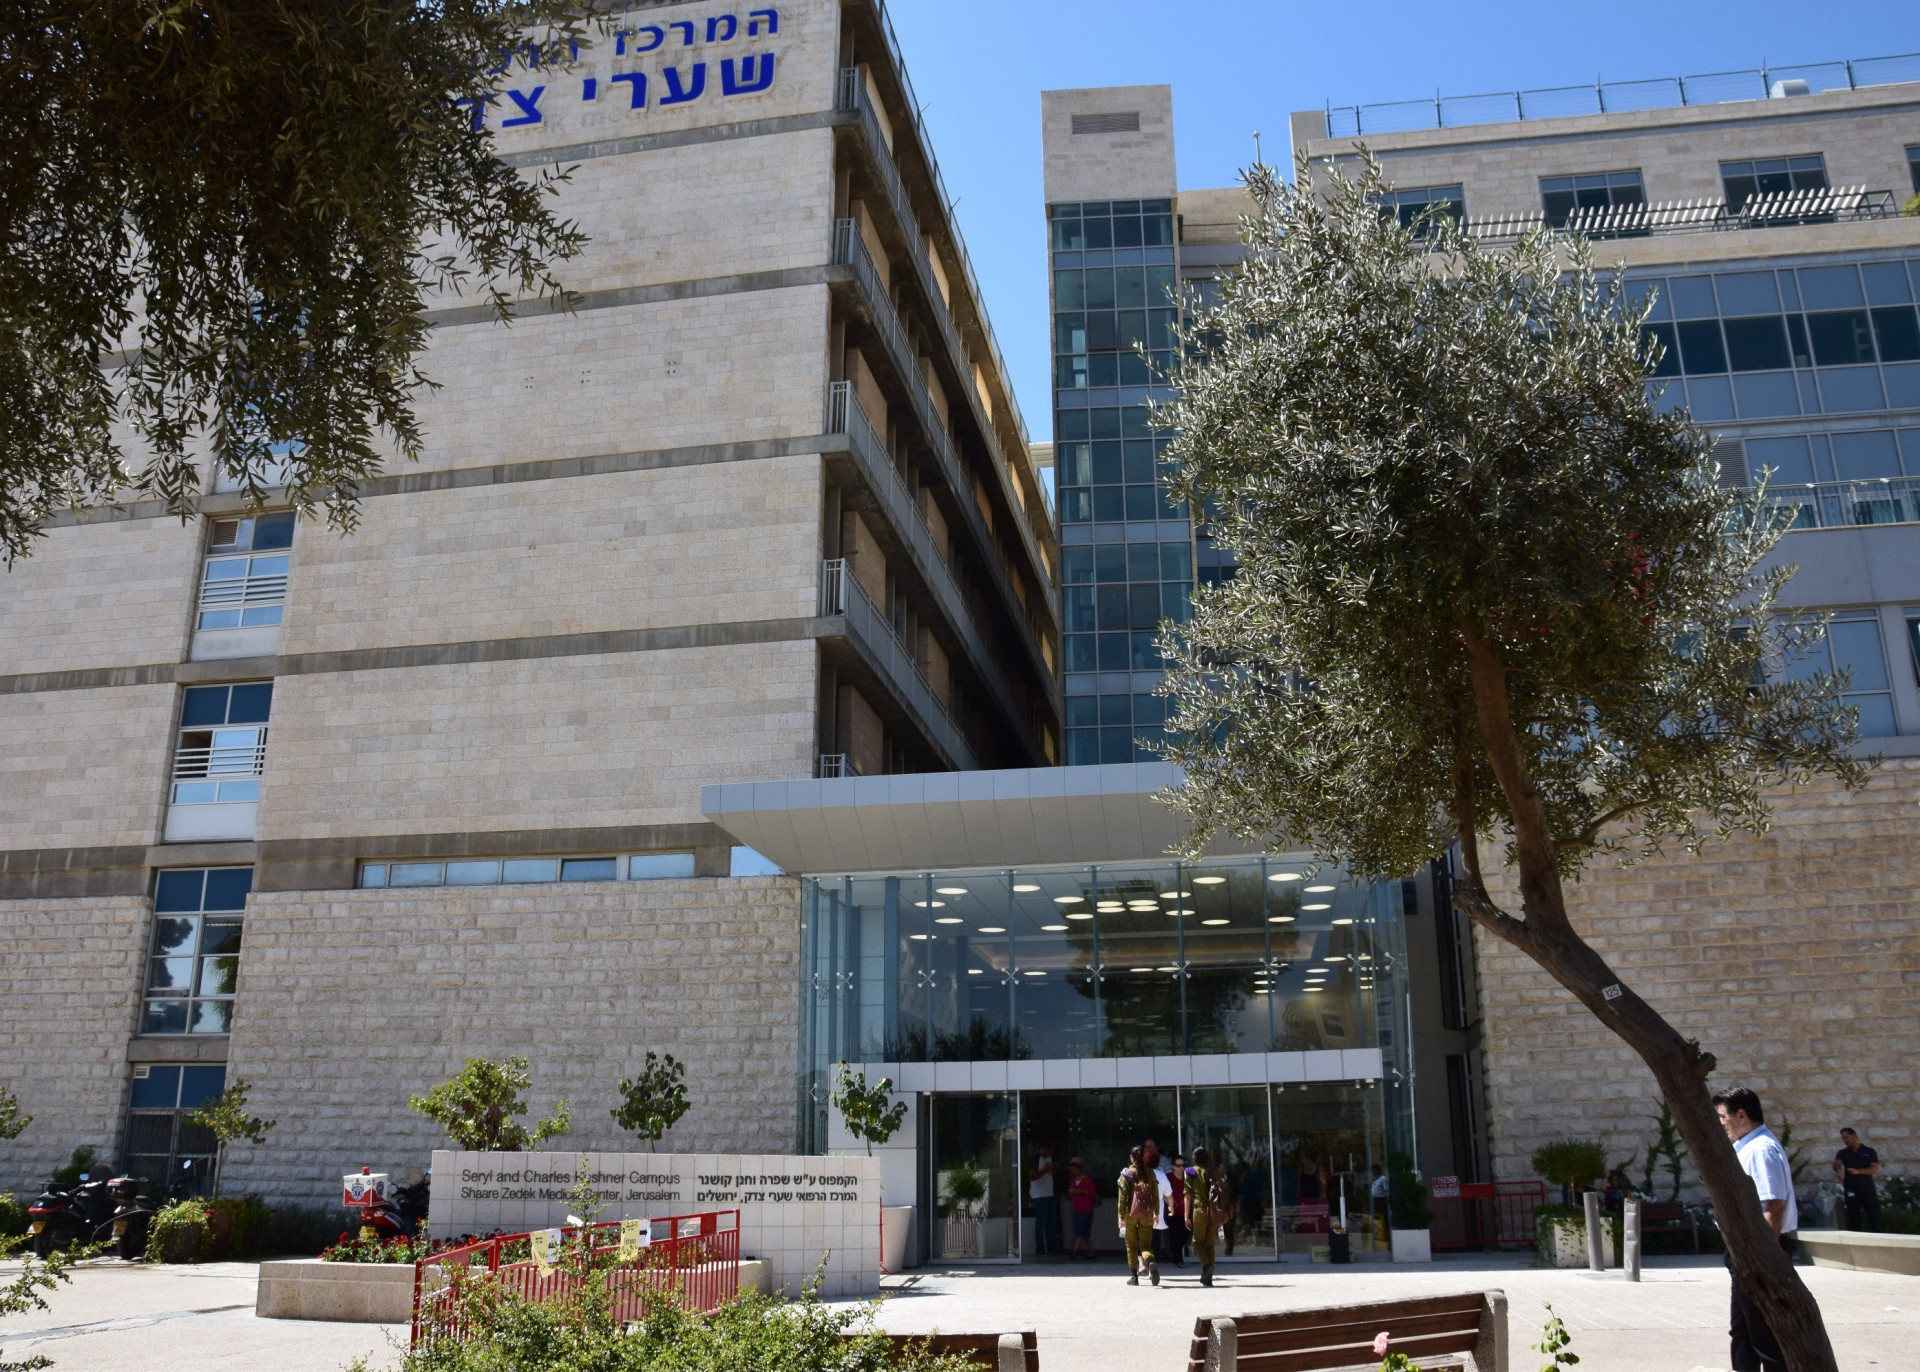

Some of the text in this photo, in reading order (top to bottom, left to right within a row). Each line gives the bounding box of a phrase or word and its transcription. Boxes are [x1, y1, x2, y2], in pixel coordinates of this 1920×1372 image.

[613, 8, 780, 57] המרכז
[582, 53, 775, 110] שערי
[456, 86, 546, 132] צד
[1605, 986, 1619, 998] 125
[462, 1169, 493, 1185] Seryl
[497, 1170, 520, 1183] and
[524, 1170, 571, 1183] Charles
[629, 1171, 681, 1187] Campus
[697, 1175, 733, 1188] קושנר
[735, 1175, 757, 1188] וחנן
[759, 1175, 791, 1186] שפרה
[818, 1175, 858, 1188] הקמפוס
[461, 1186, 499, 1199] Shaare
[502, 1187, 536, 1199] Zedek
[626, 1189, 681, 1201] Jerusalem
[697, 1189, 858, 1204] המרכז הרפואי שערי צדק, ירושלים
